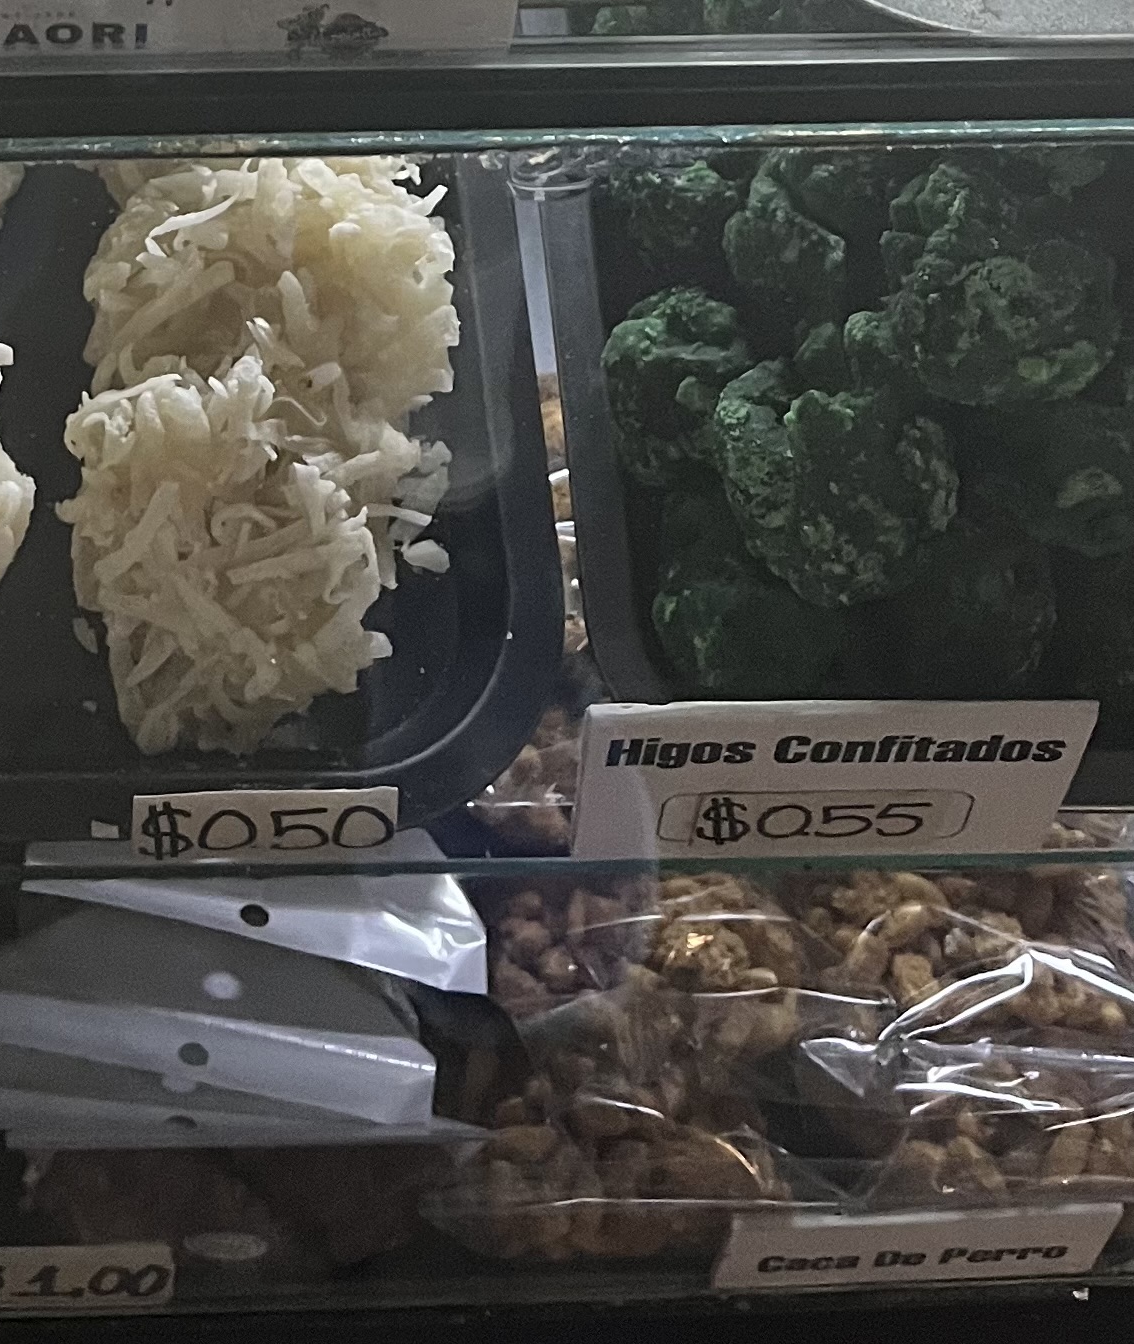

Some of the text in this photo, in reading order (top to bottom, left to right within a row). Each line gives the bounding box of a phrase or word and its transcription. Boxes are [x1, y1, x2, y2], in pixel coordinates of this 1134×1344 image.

[604, 734, 1067, 769] Higos Confitados
[937, 1244, 1068, 1265] Perro
